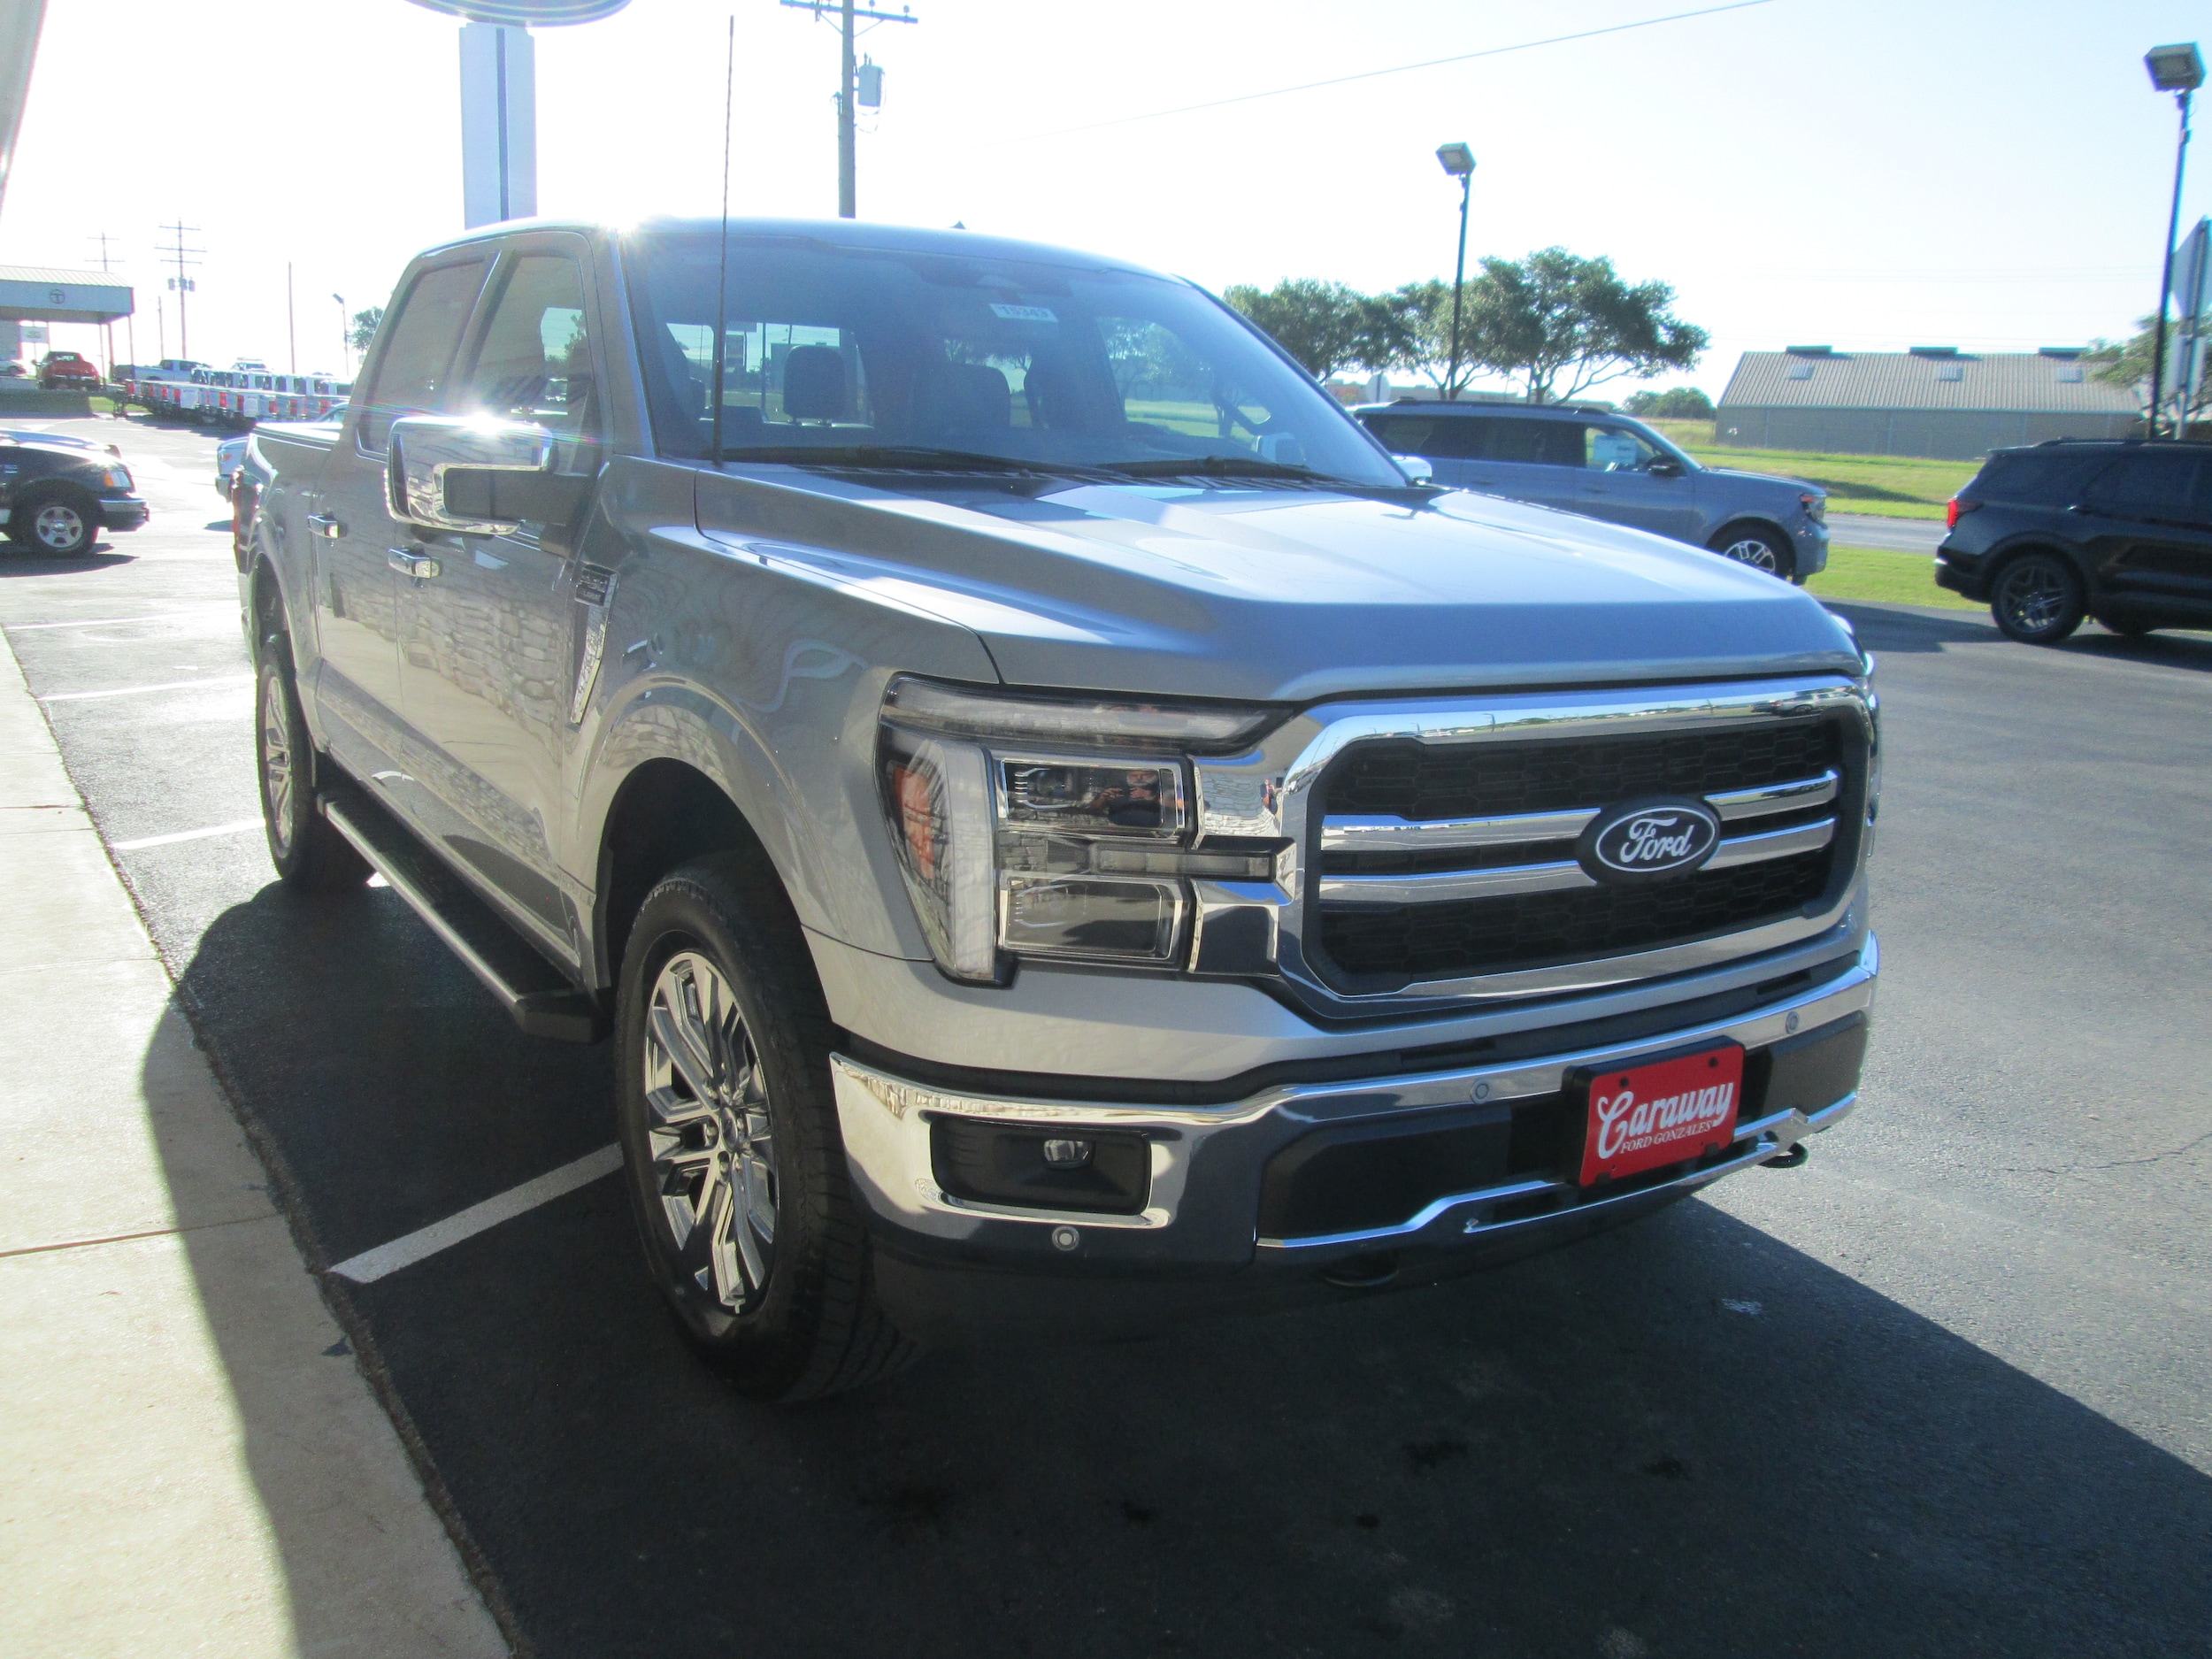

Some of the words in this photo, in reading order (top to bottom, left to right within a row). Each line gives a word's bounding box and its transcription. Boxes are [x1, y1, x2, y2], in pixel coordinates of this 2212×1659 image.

[1619, 816, 1695, 864] Ford
[1597, 1082, 1734, 1160] Caraway
[1620, 1136, 1653, 1154] FORD
[1653, 1120, 1713, 1146] GONZALES
